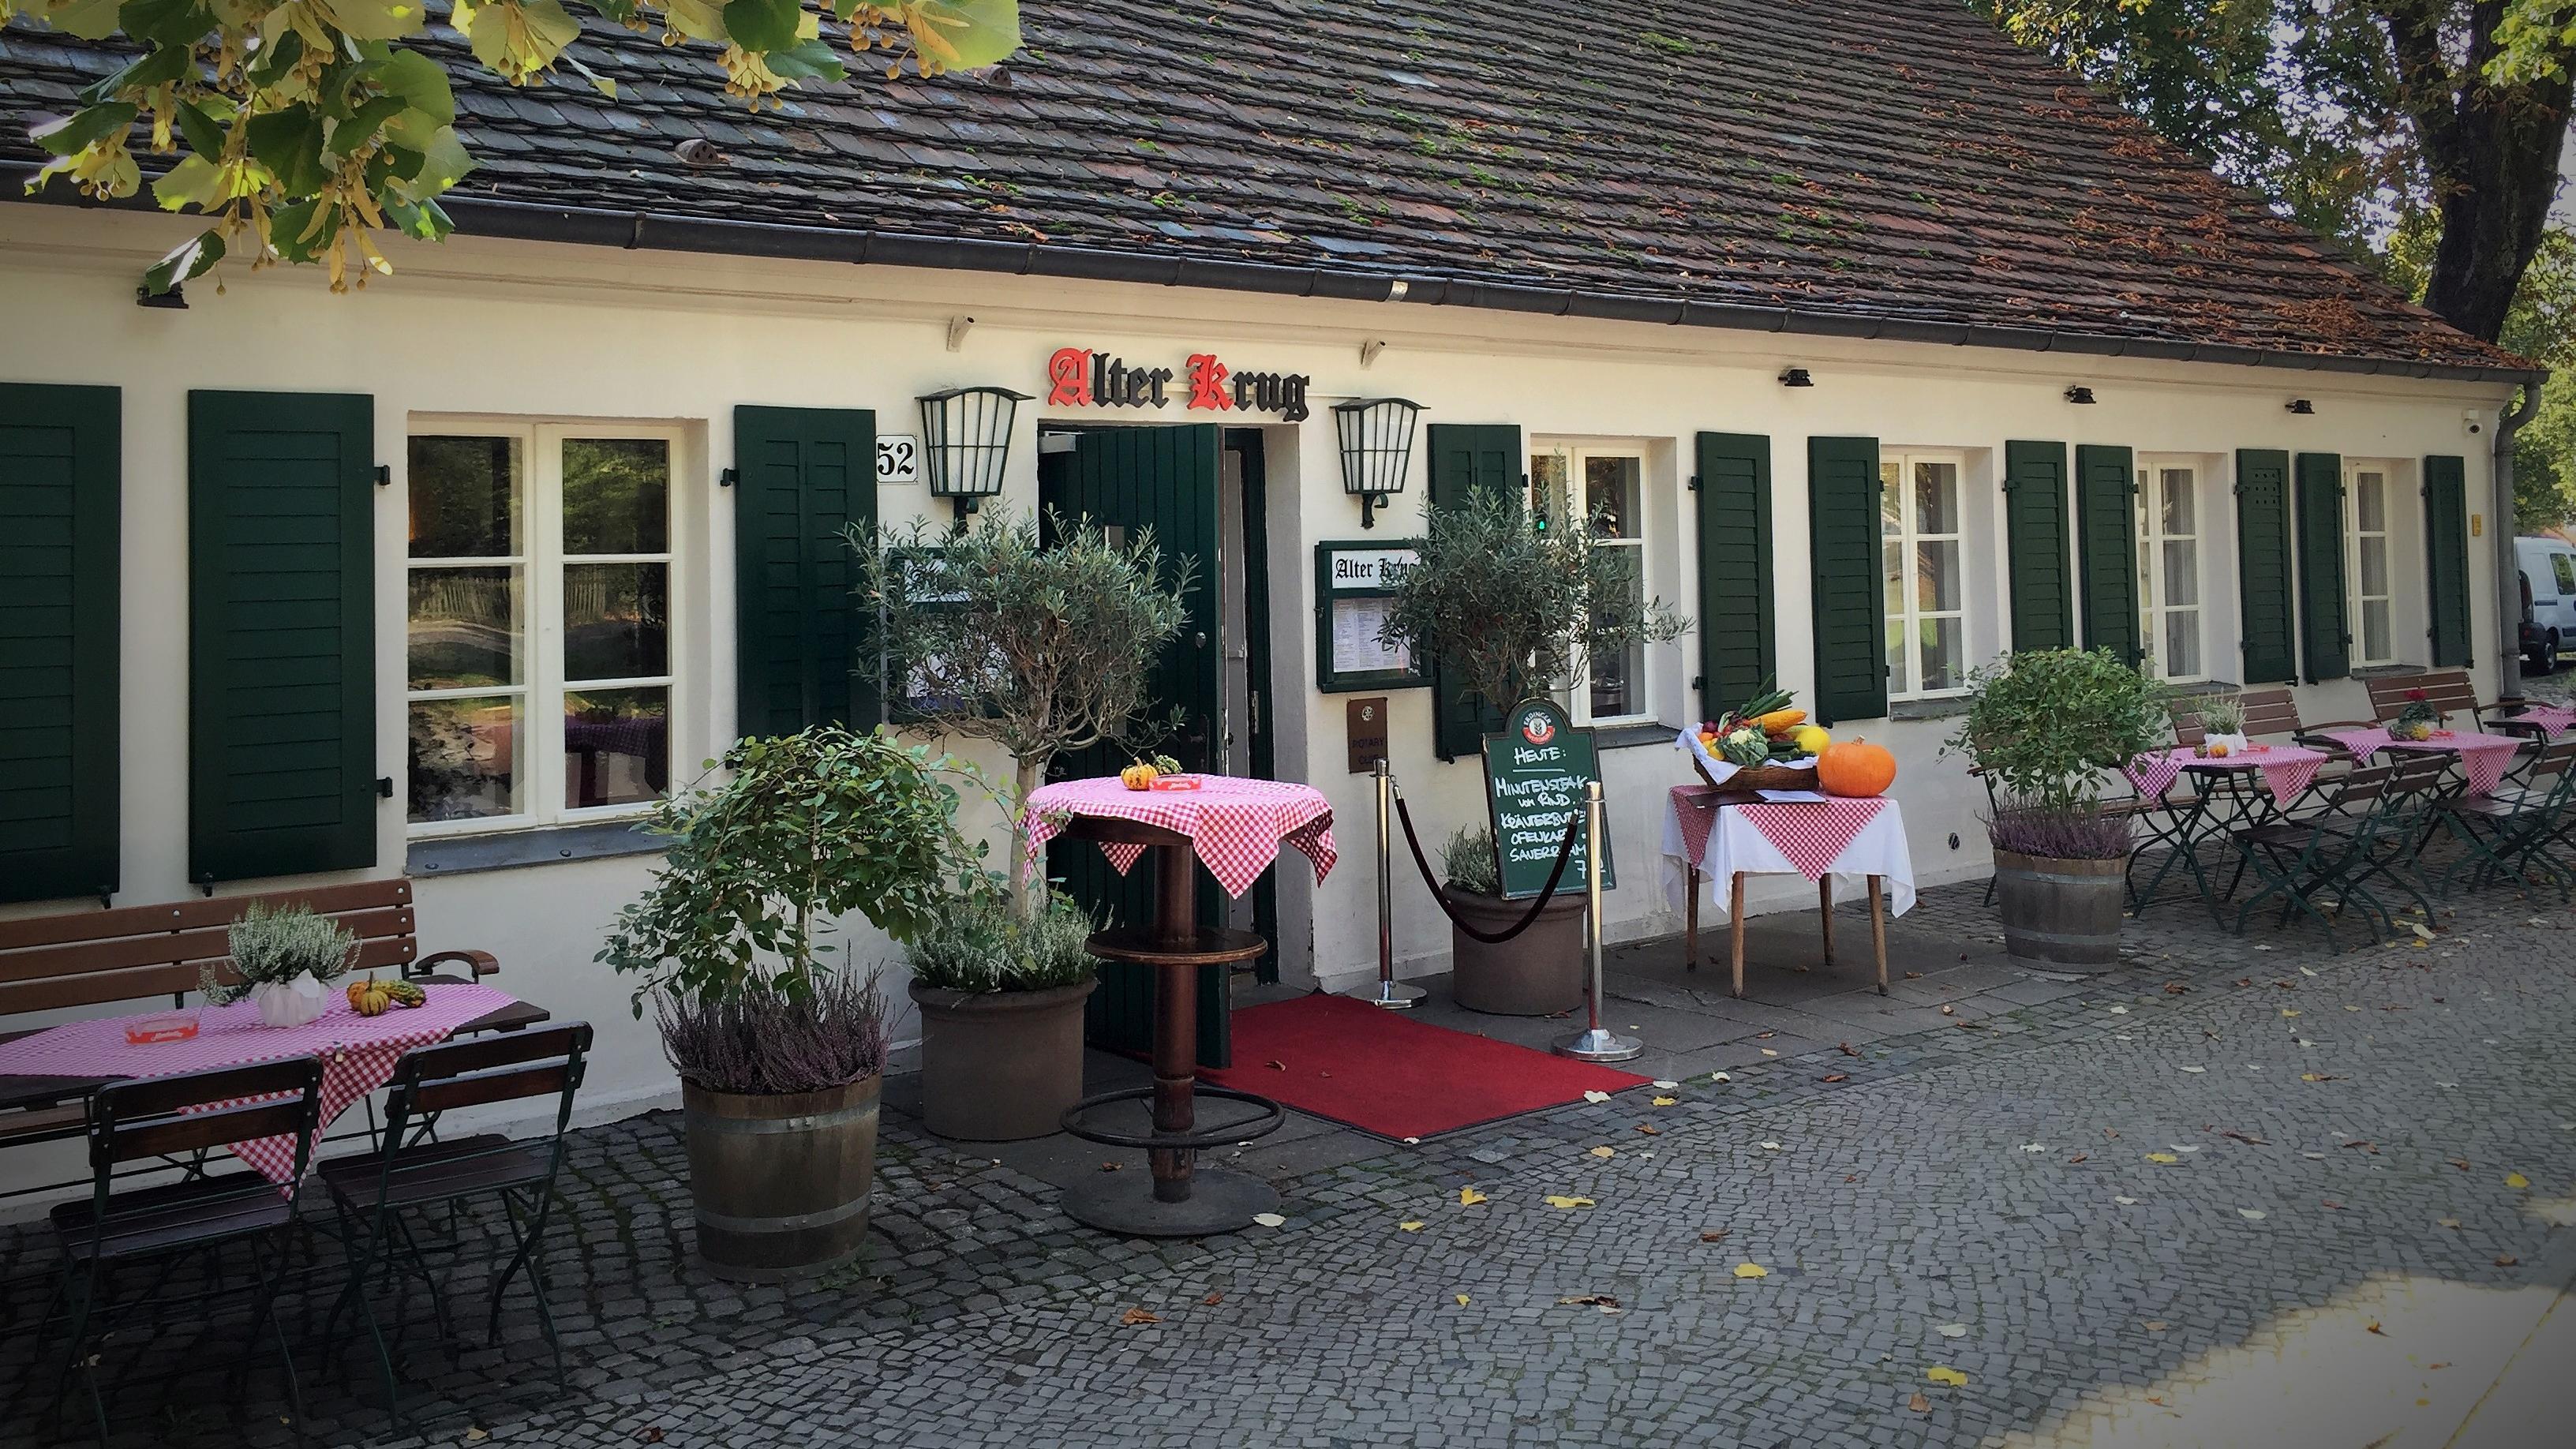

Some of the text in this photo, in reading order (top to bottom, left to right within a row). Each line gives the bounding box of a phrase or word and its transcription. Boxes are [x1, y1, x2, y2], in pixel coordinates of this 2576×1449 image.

[1048, 347, 1310, 422] Alter Krug
[878, 442, 914, 475] 52
[1335, 558, 1373, 579] Alter
[1523, 711, 1552, 725] ERDINGER
[1514, 747, 1567, 766] HEUTE:
[1494, 775, 1588, 798] MINUTENSTEAK
